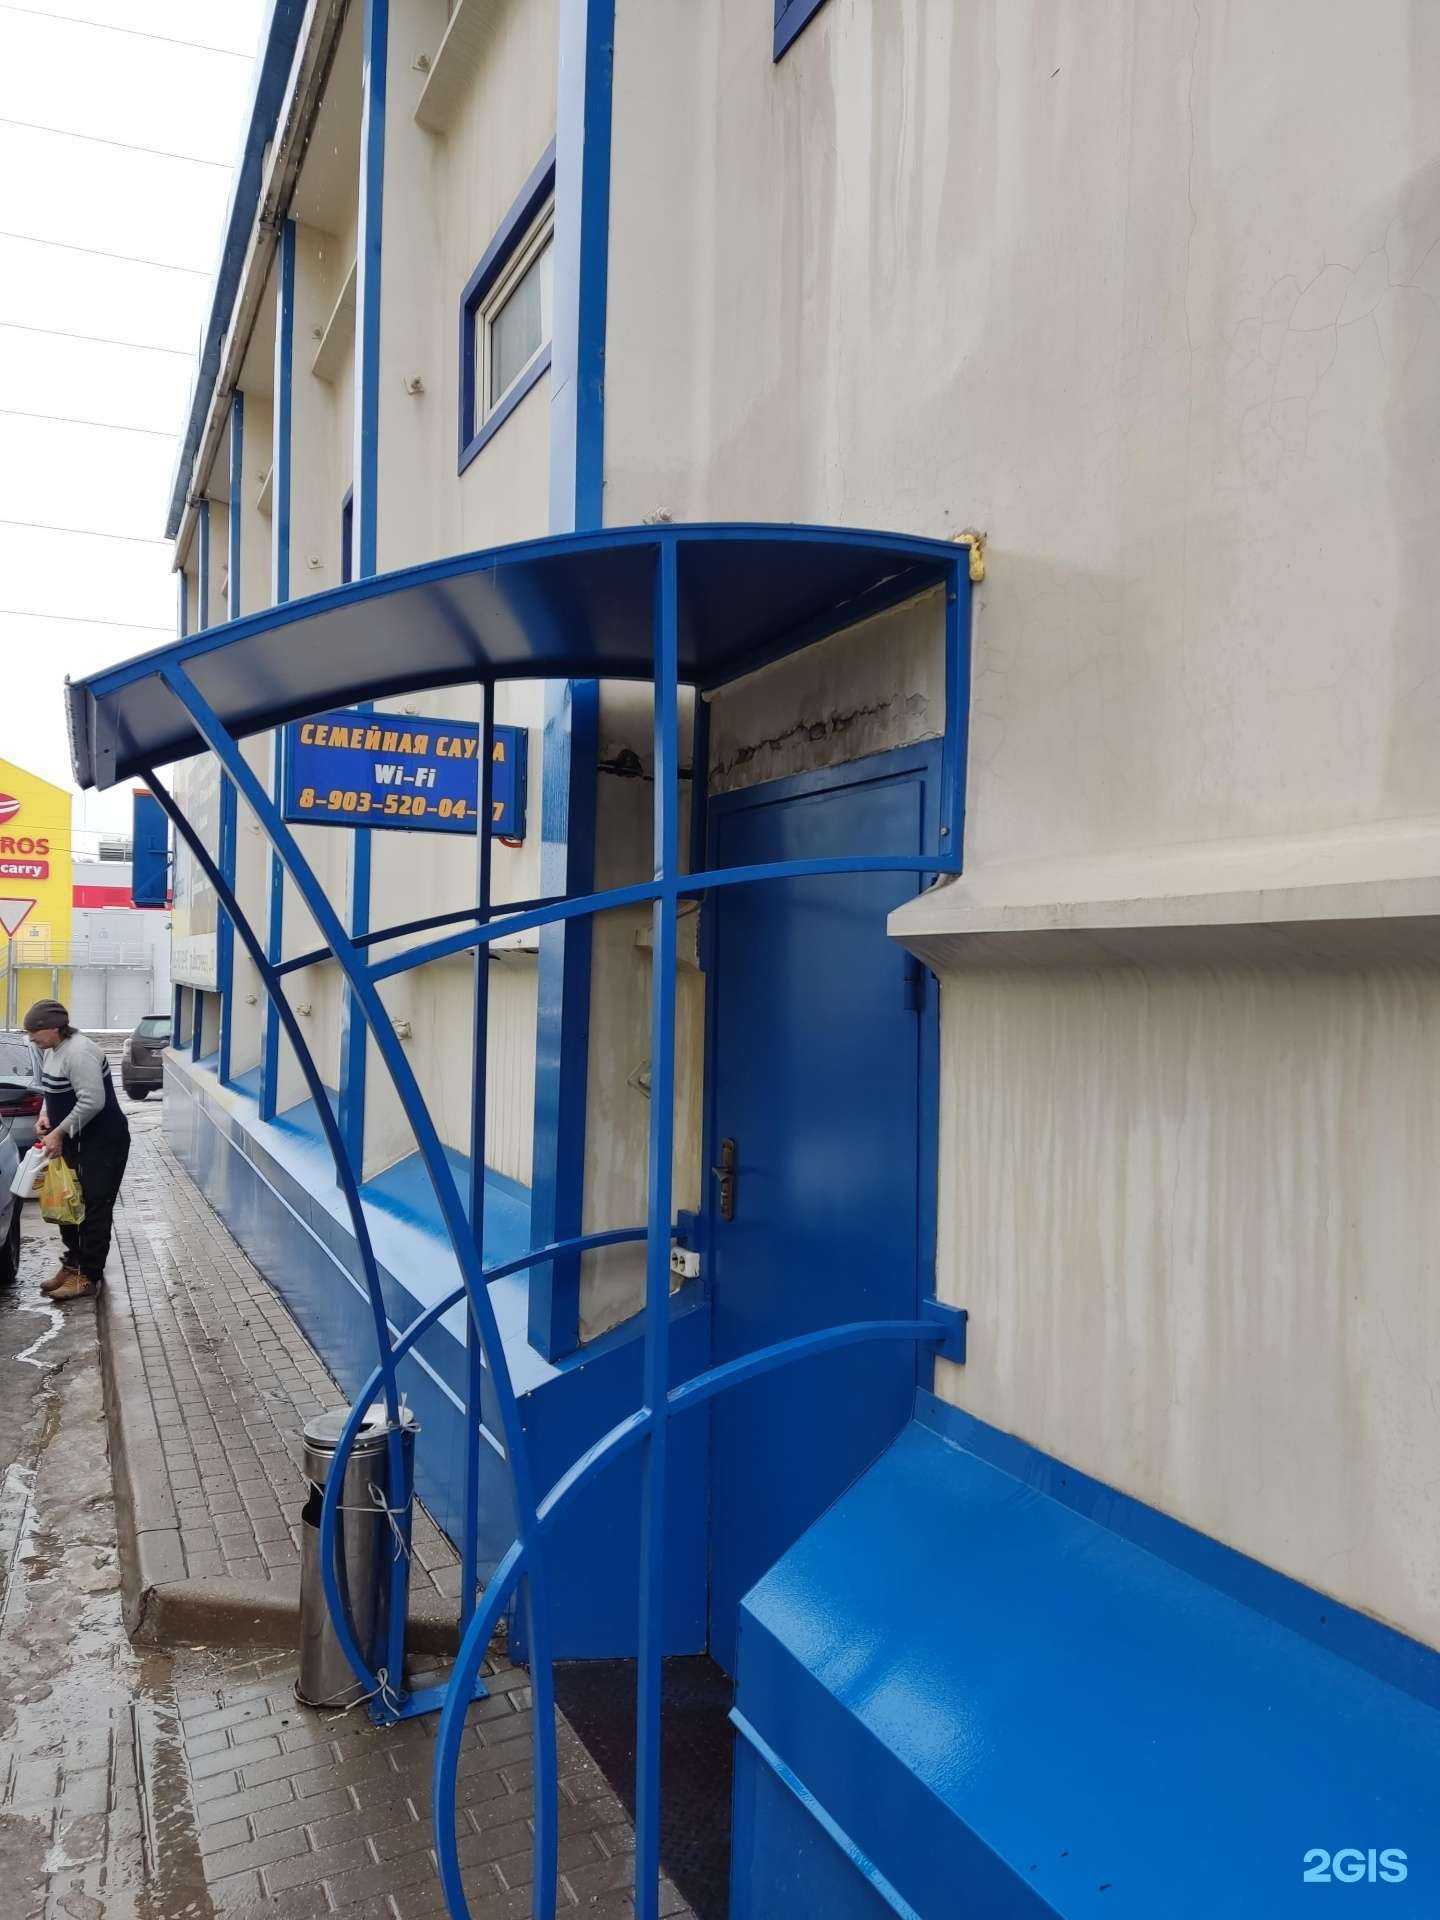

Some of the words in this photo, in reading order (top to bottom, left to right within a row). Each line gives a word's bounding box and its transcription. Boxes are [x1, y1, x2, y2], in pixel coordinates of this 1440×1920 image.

[301, 724, 428, 755] СЕМЕЙНАЯ
[435, 736, 505, 762] САУА
[374, 763, 437, 789] Wi-Fi
[300, 788, 505, 821] 8-903-520-04-7
[0, 864, 41, 877] carry
